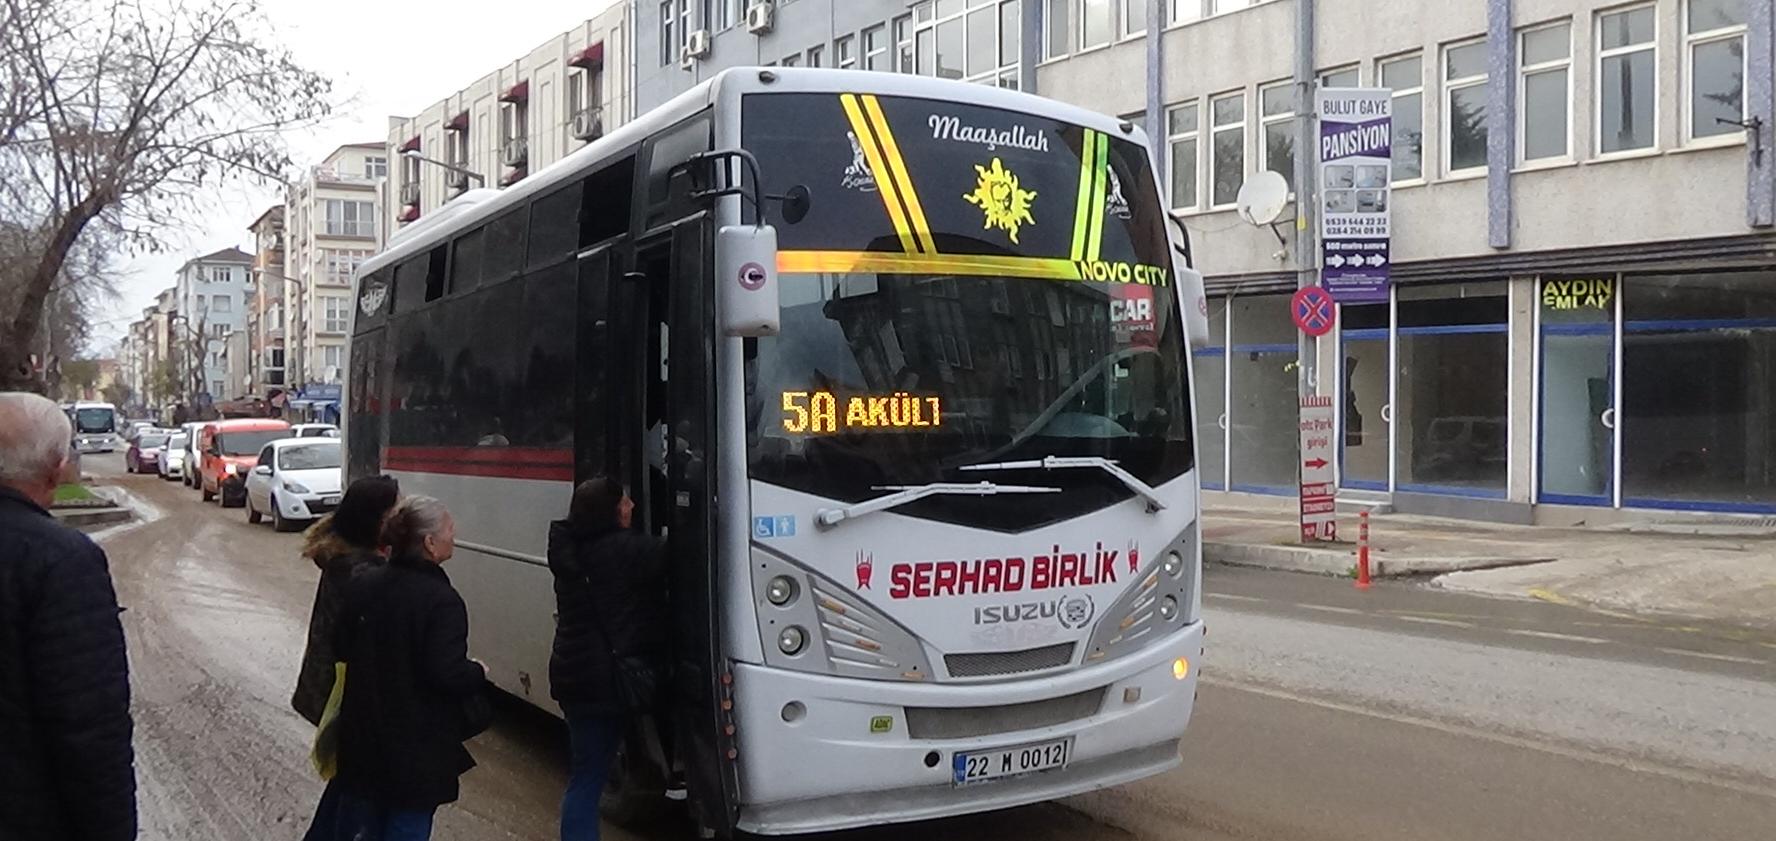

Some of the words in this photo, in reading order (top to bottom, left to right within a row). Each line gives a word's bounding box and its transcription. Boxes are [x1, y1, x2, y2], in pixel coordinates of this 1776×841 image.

[1323, 100, 1356, 114] BULUT
[1360, 100, 1387, 114] GAYE
[928, 114, 1049, 152] Maaşallah
[1322, 123, 1389, 160] PANSİYON
[1080, 260, 1131, 283] NOVO
[1133, 264, 1167, 287] CITY
[1542, 279, 1612, 296] AYDIN
[1110, 298, 1152, 322] CAR
[783, 391, 837, 433] 5A
[889, 558, 1025, 599] SERHAD
[1031, 541, 1118, 590] BİRLİK
[974, 600, 1056, 625] ISUZU
[967, 756, 989, 778] 22
[1001, 753, 1012, 773] M
[1020, 744, 1062, 769] 0012
